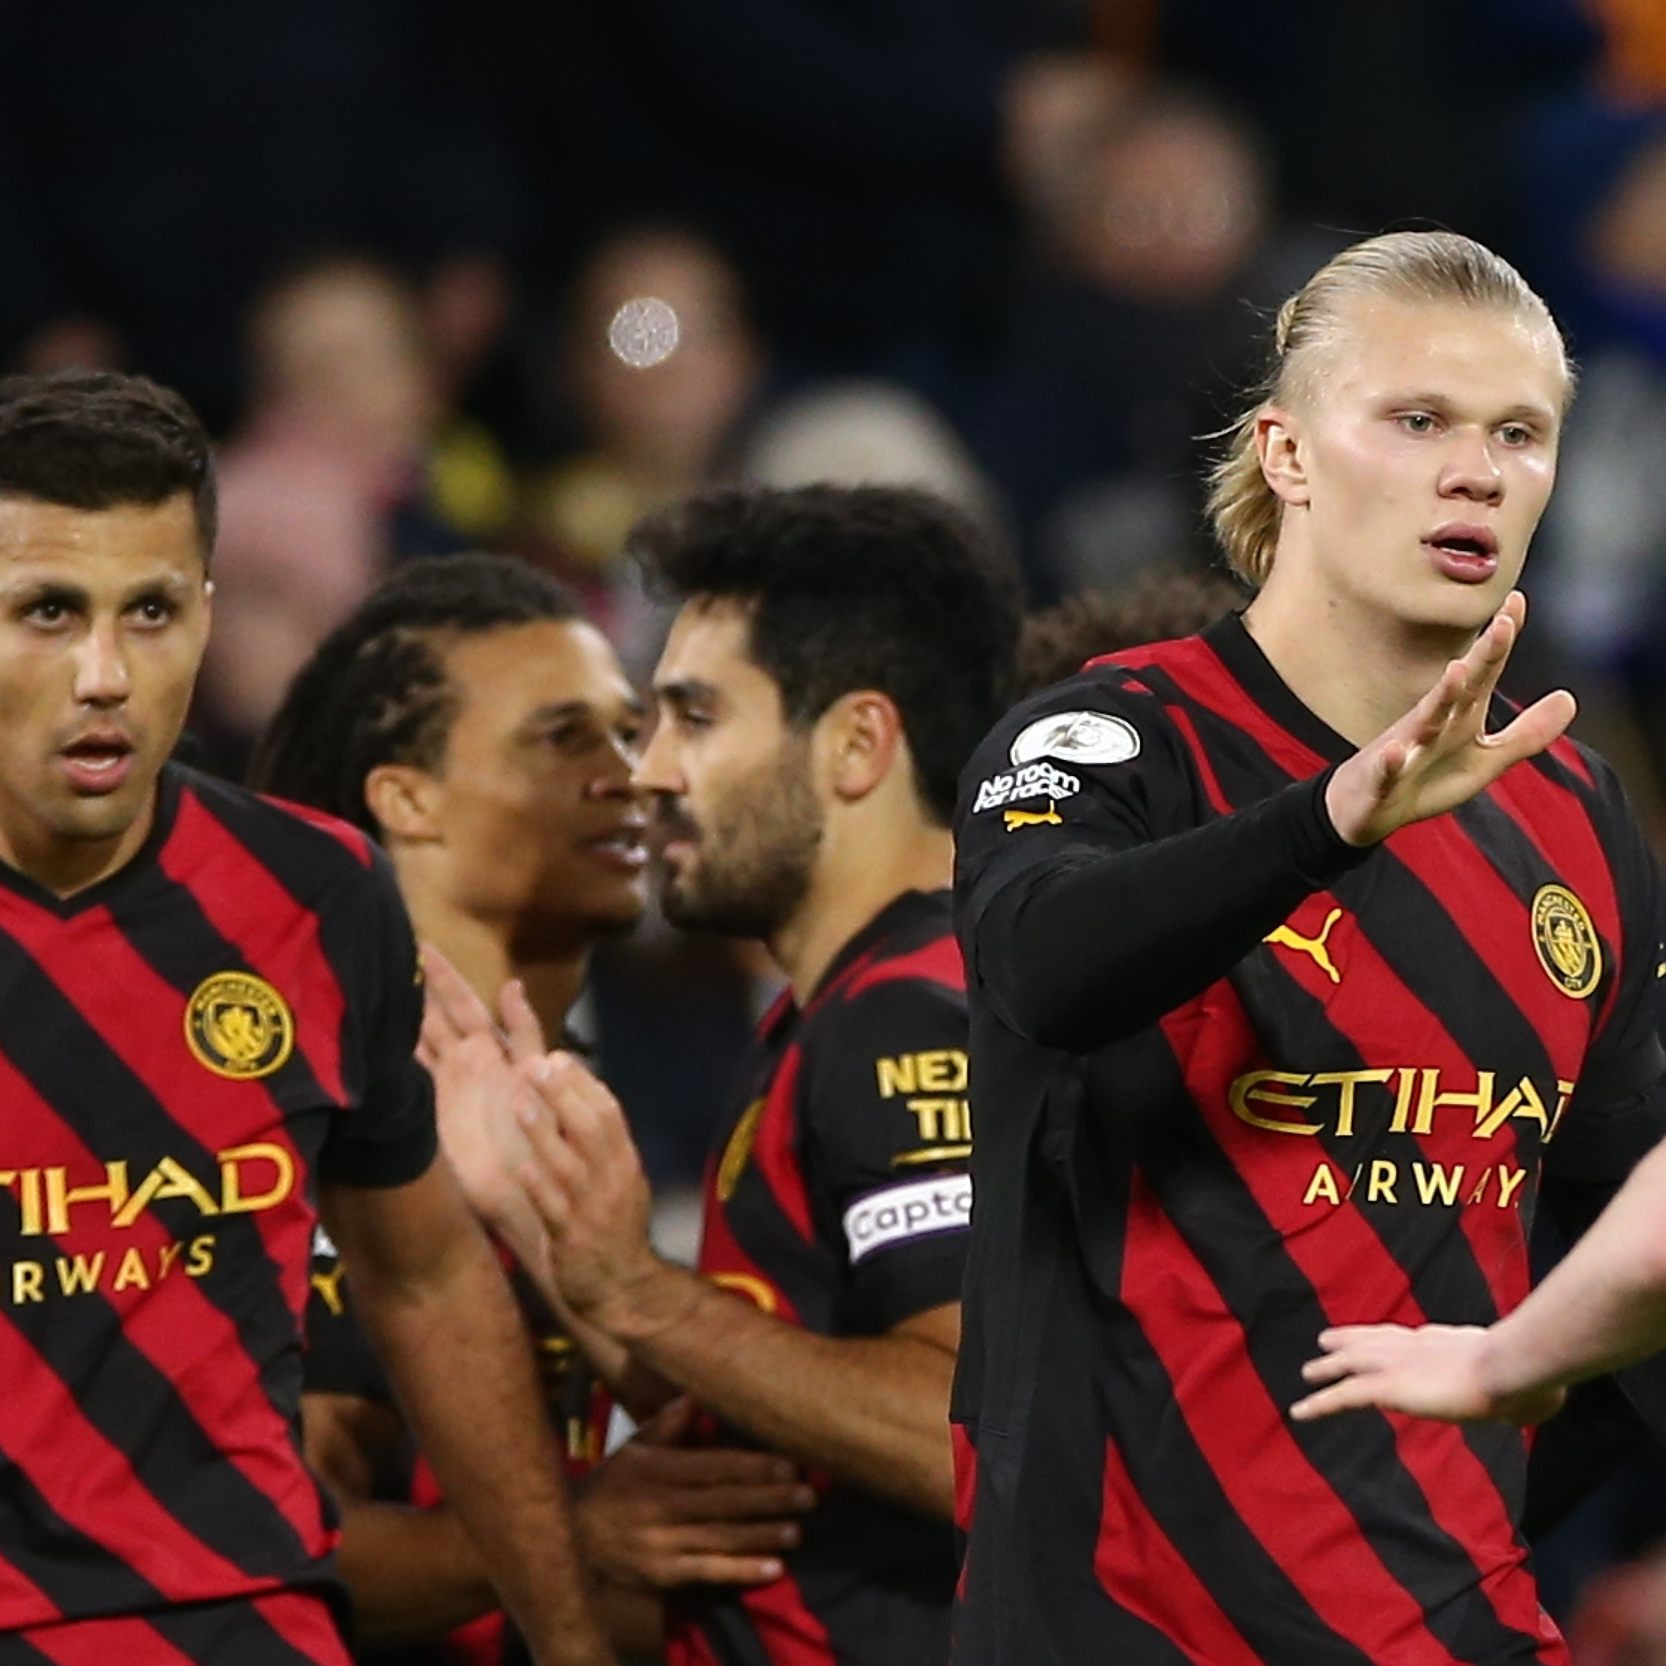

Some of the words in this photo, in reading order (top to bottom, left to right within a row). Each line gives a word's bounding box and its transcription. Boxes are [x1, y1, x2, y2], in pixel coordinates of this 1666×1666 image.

[977, 774, 1014, 801] No
[1016, 762, 1080, 793] room
[876, 1049, 970, 1098] NEX
[906, 1098, 973, 1141] TI
[852, 1192, 972, 1241] Capta
